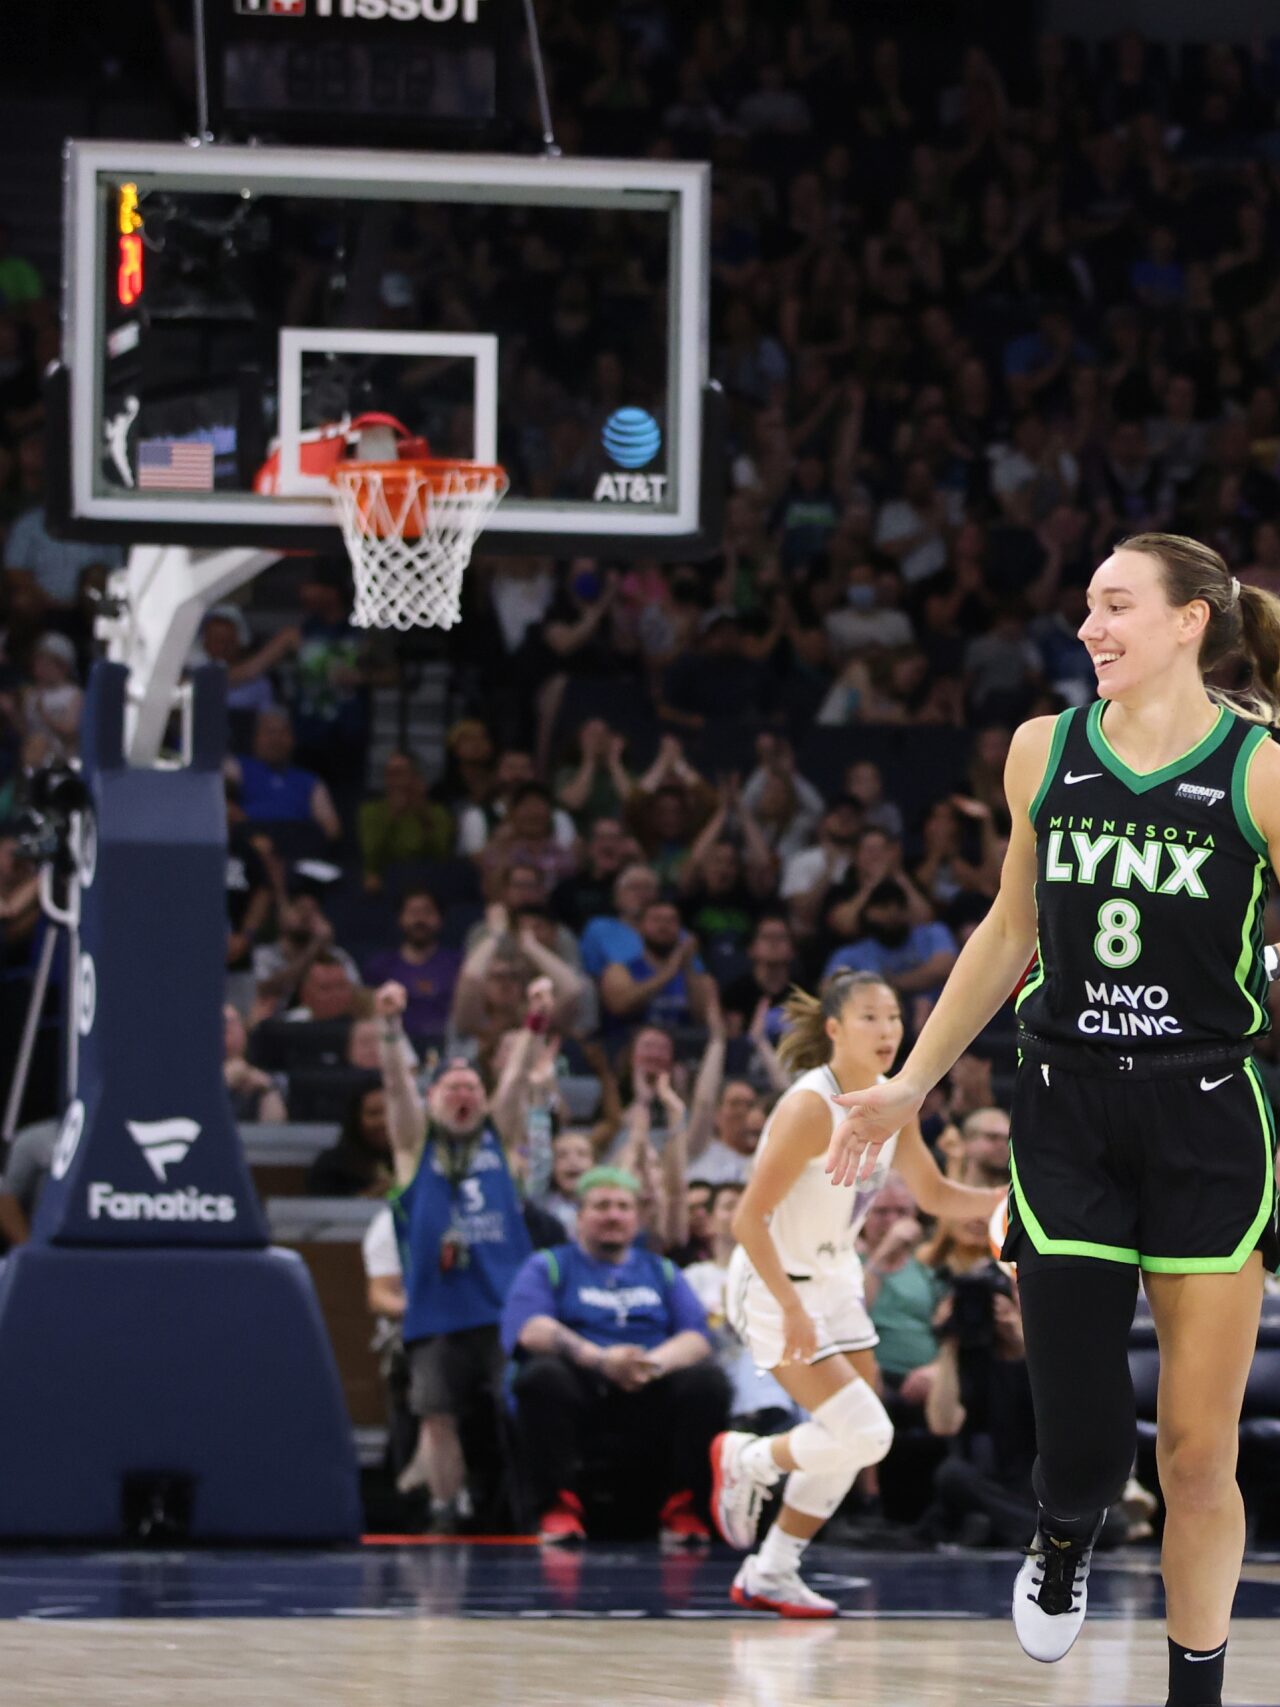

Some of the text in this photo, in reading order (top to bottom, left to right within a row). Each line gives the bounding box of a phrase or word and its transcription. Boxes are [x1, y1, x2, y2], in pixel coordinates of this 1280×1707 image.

[594, 472, 667, 503] AT&T
[1178, 783, 1225, 800] FEDERATED
[1050, 816, 1215, 848] MINNESOTA
[1046, 830, 1213, 899] LYNX
[1094, 898, 1142, 969] 8
[1084, 980, 1169, 1010] MAYO
[1077, 1009, 1184, 1036] CLINIC
[88, 1181, 237, 1222] Fanatics
